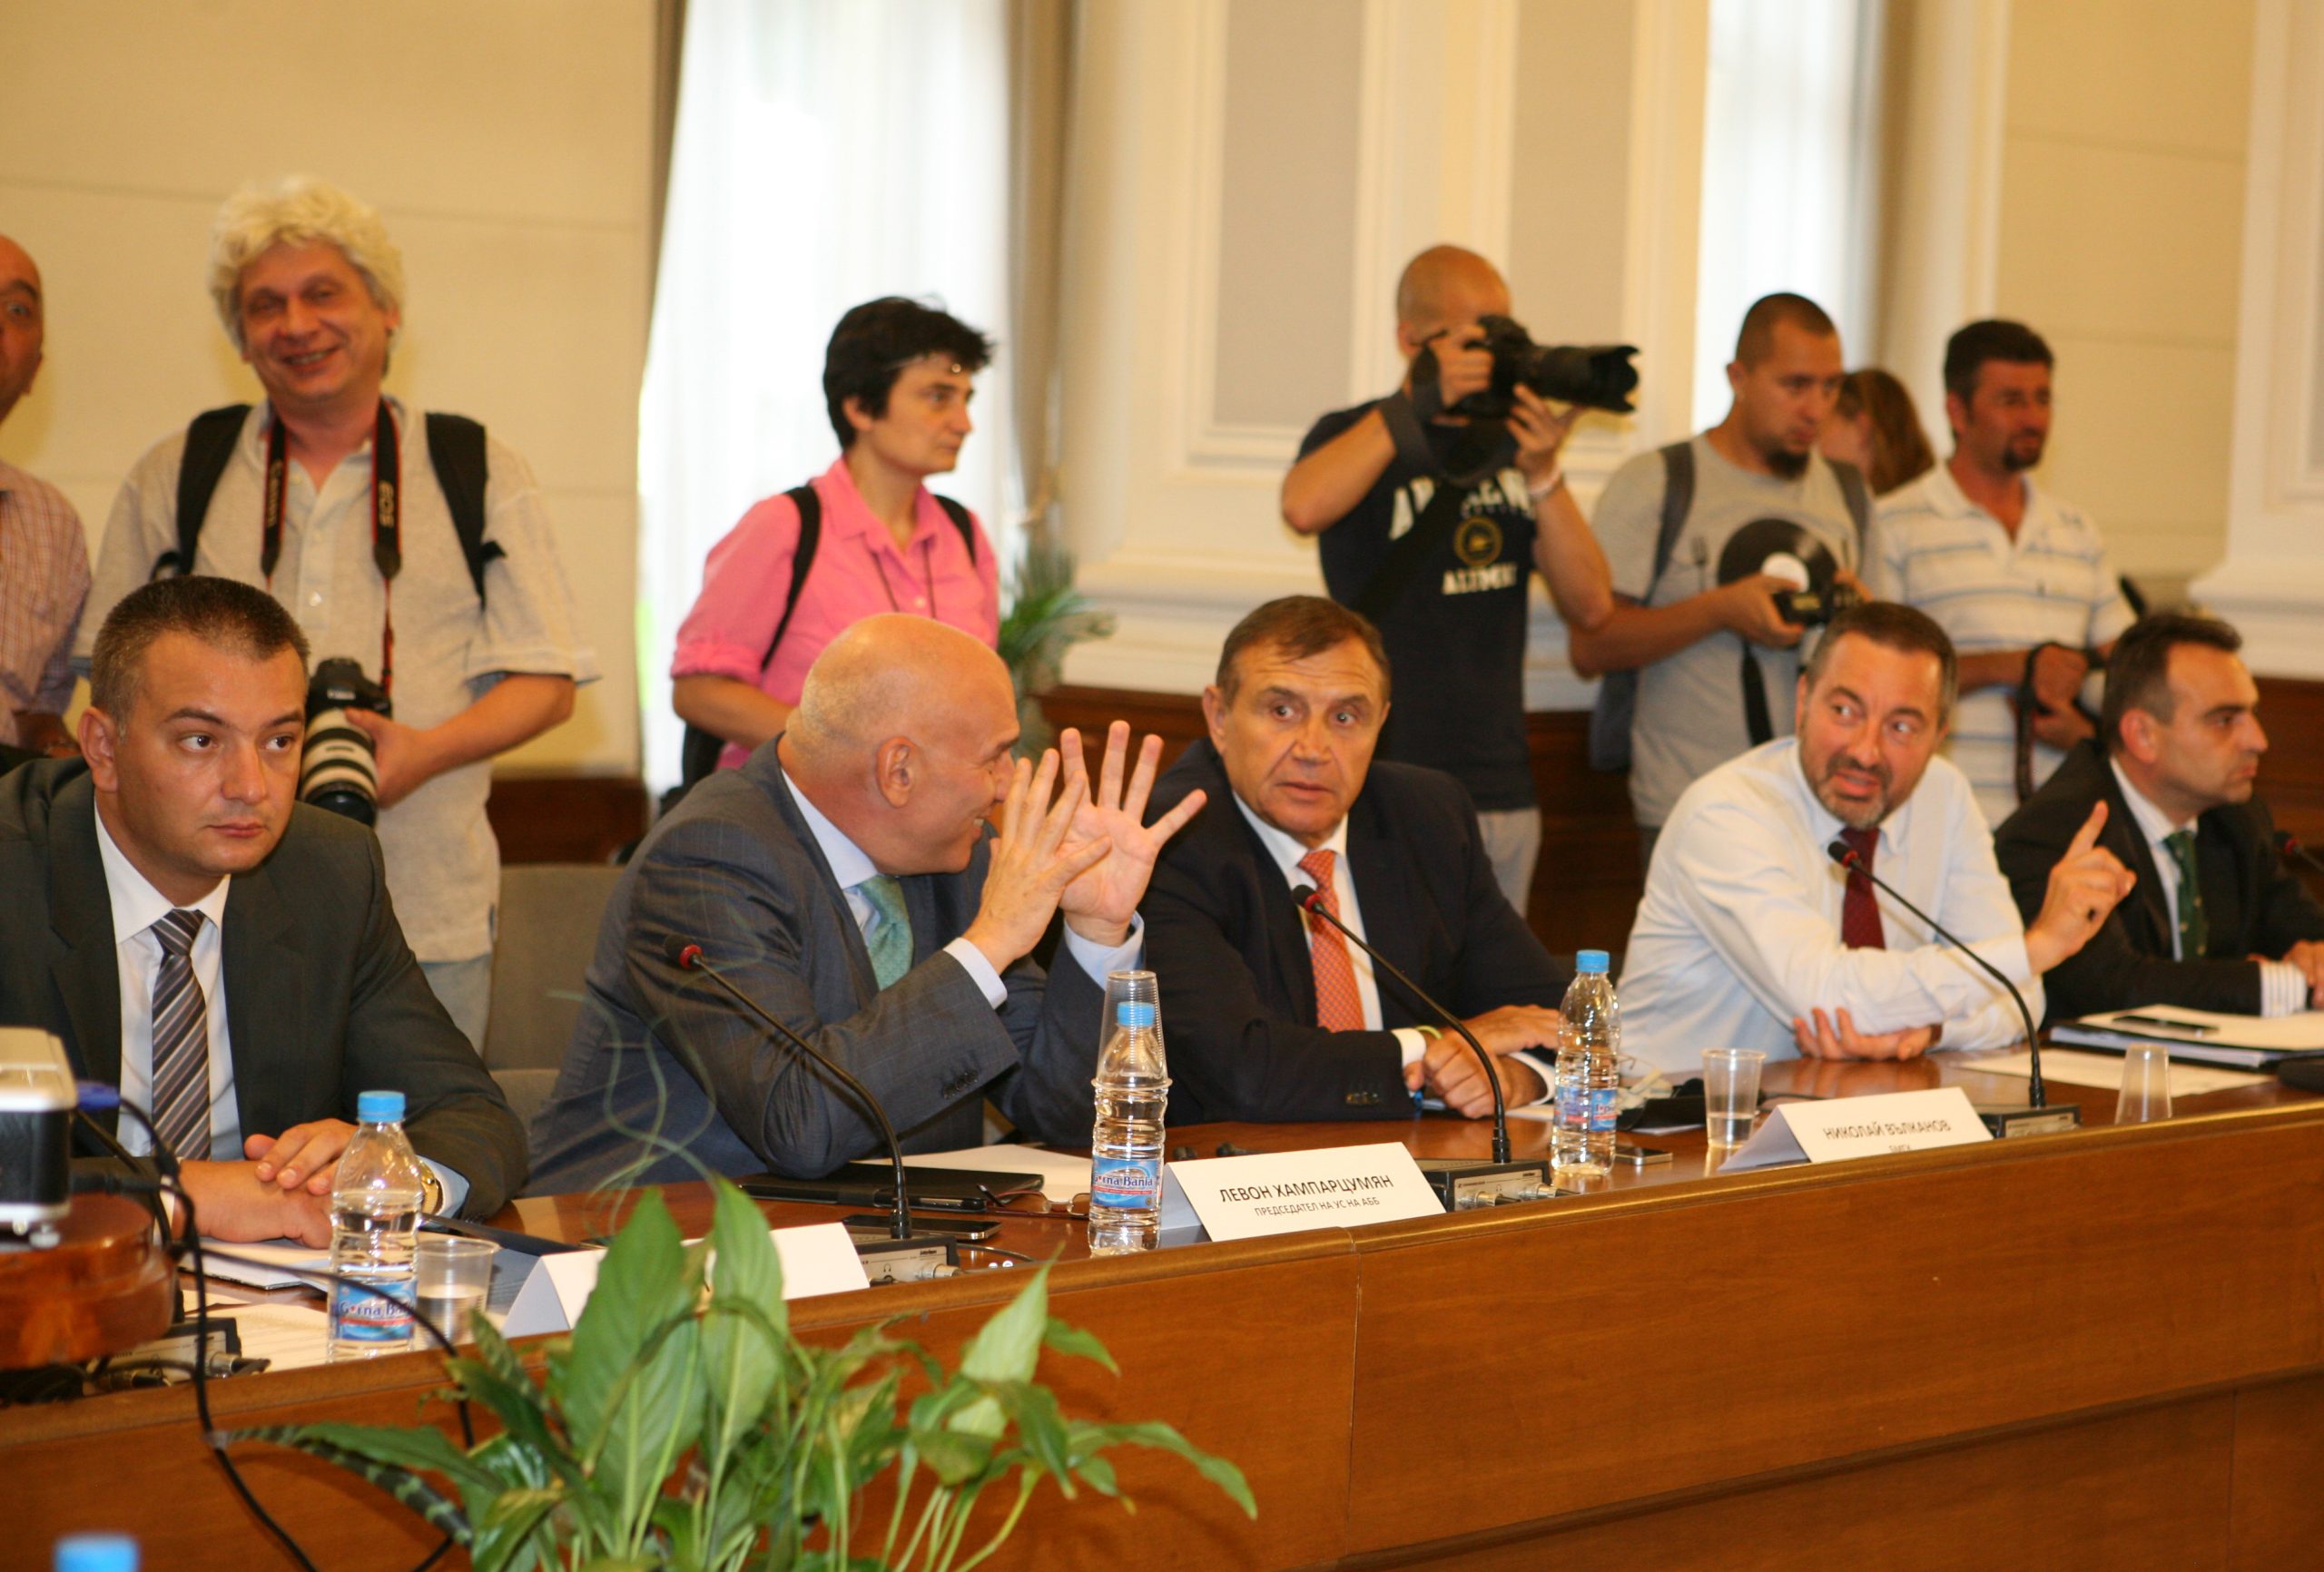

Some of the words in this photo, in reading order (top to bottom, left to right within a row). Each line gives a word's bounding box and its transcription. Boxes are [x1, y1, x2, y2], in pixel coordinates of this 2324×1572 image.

[1823, 1121, 1885, 1139] НИКОЛАЙ
[1885, 1120, 1951, 1135] ВЪЛКАНОВ
[1123, 1175, 1153, 1186] Bania
[1219, 1185, 1273, 1202] ЛЕВОН
[1273, 1175, 1393, 1197] ХАМПАРЦУМЯН
[1255, 1203, 1319, 1216] ПРЕДСЕДАТЕЛ
[1320, 1201, 1333, 1211] НА
[1334, 1199, 1346, 1209] УС
[1347, 1198, 1361, 1208] НА
[1362, 1196, 1381, 1206] АББ
